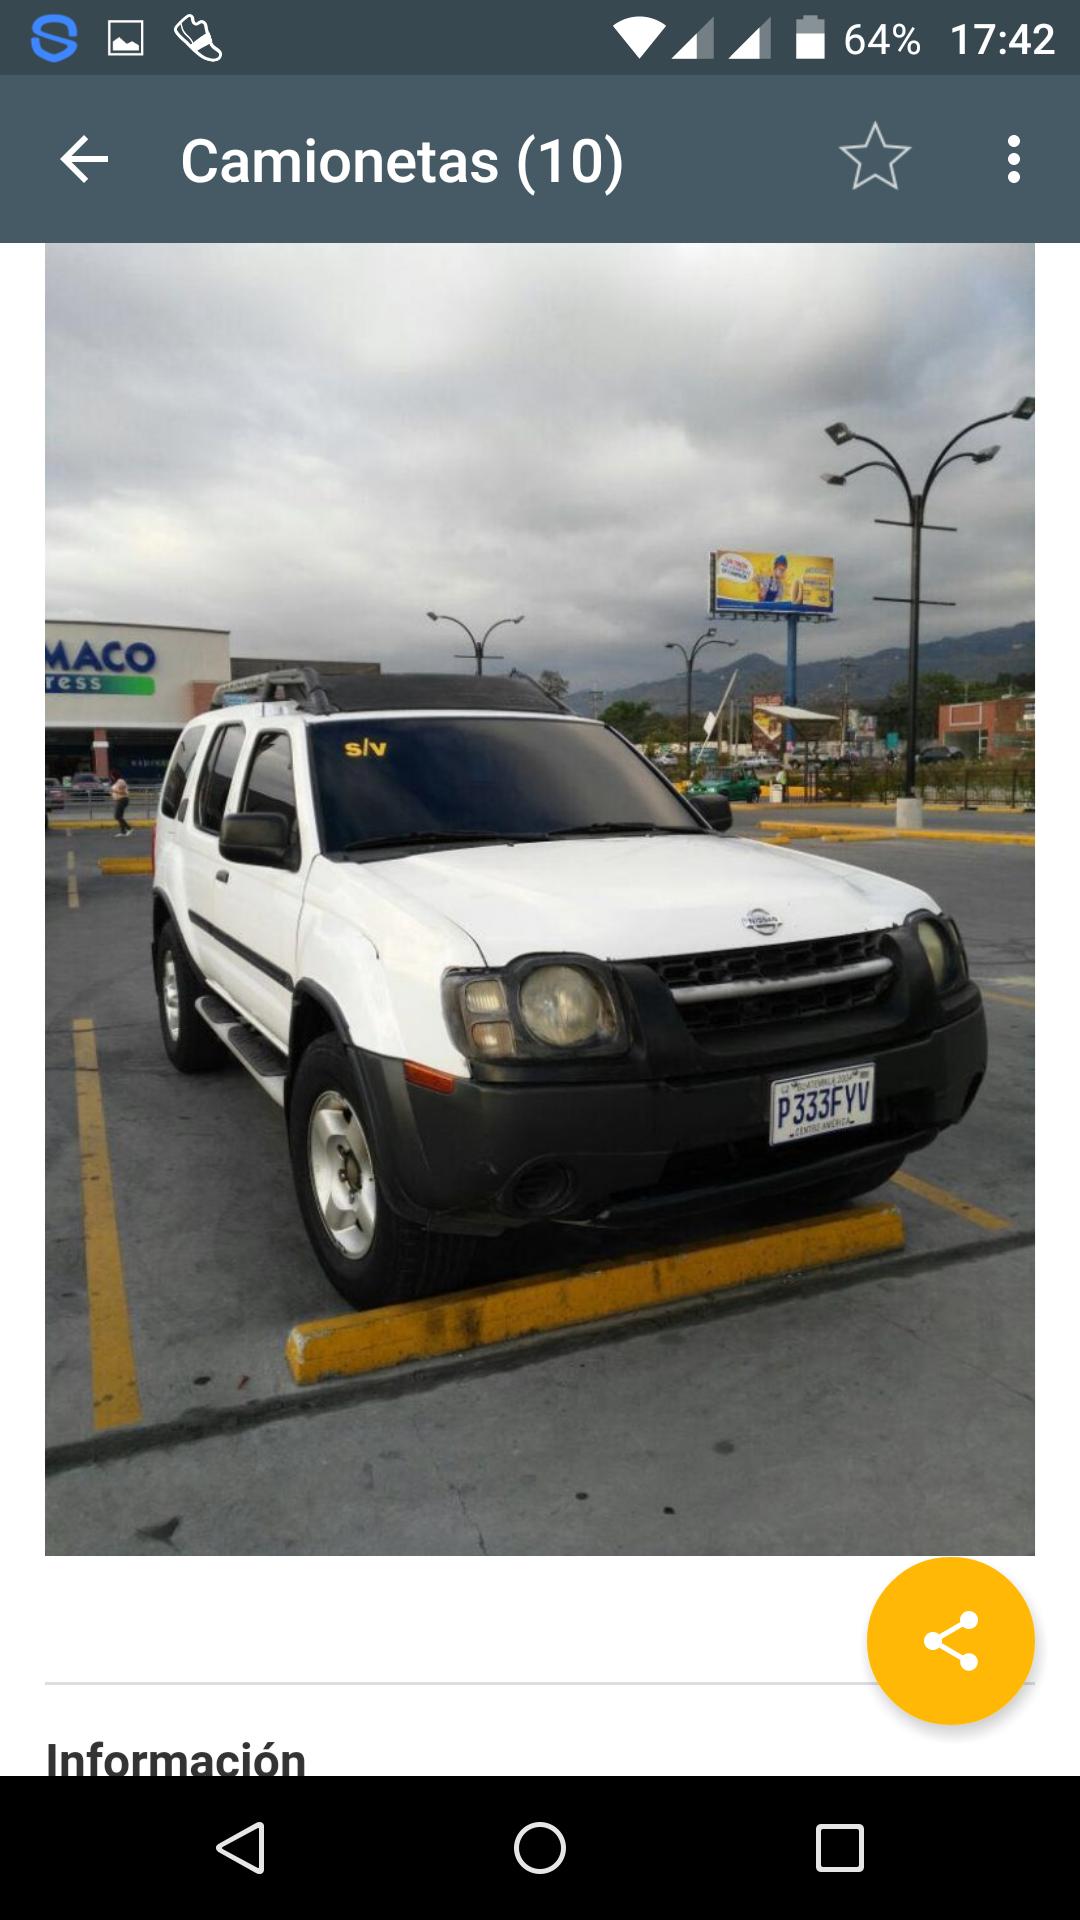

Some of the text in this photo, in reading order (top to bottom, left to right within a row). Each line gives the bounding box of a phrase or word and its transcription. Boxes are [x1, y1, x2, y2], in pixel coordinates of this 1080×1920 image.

[845, 23, 1055, 56] 64% 17:42
[182, 134, 623, 195] Camionetas (10)
[45, 640, 156, 673] MACO
[46, 676, 102, 690] ress
[778, 1081, 870, 1129] P333FYV
[48, 1741, 305, 1776] Información
